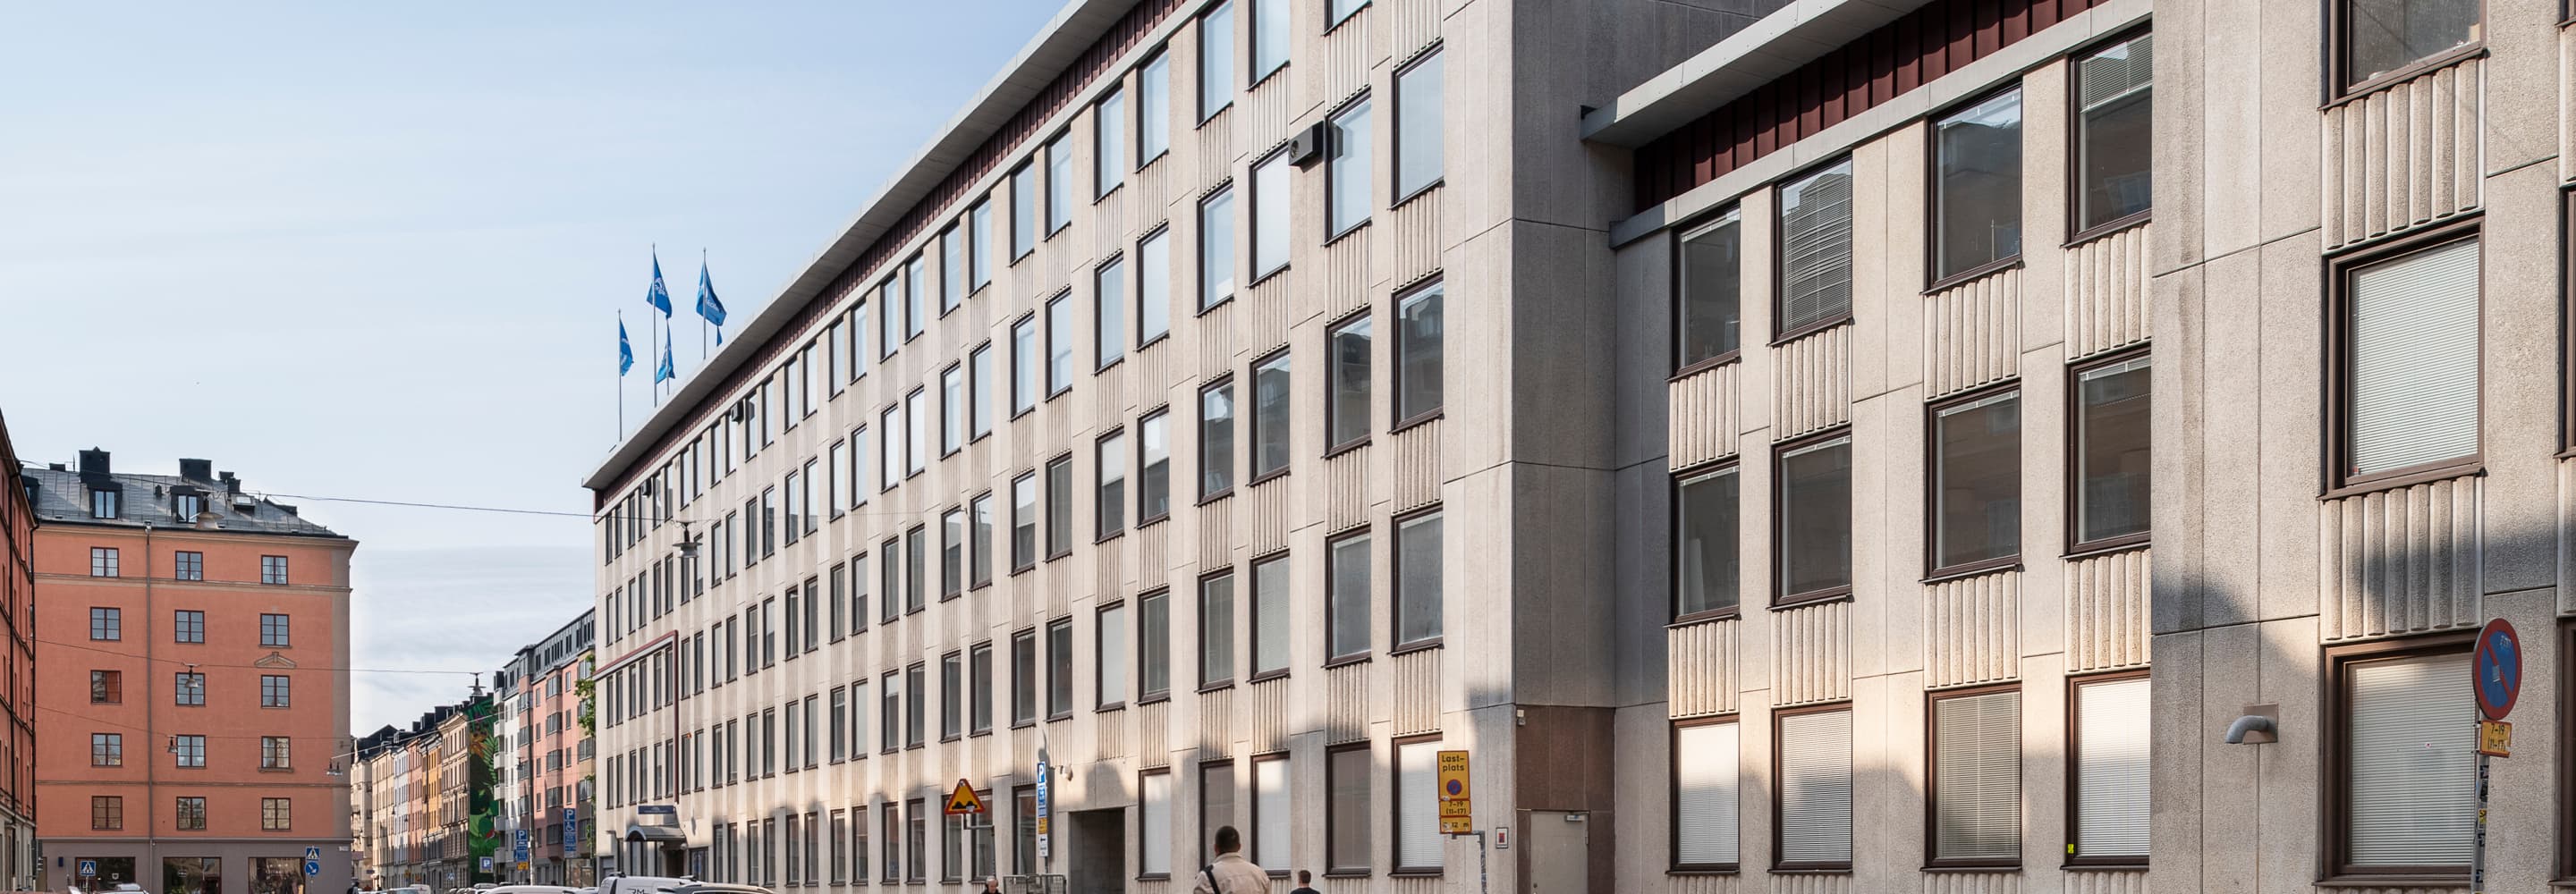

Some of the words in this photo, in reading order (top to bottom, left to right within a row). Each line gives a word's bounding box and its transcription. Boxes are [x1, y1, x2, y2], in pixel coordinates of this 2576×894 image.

[2491, 723, 2504, 735] 7-19
[1442, 755, 1465, 763] Last-
[1442, 764, 1464, 772] plats
